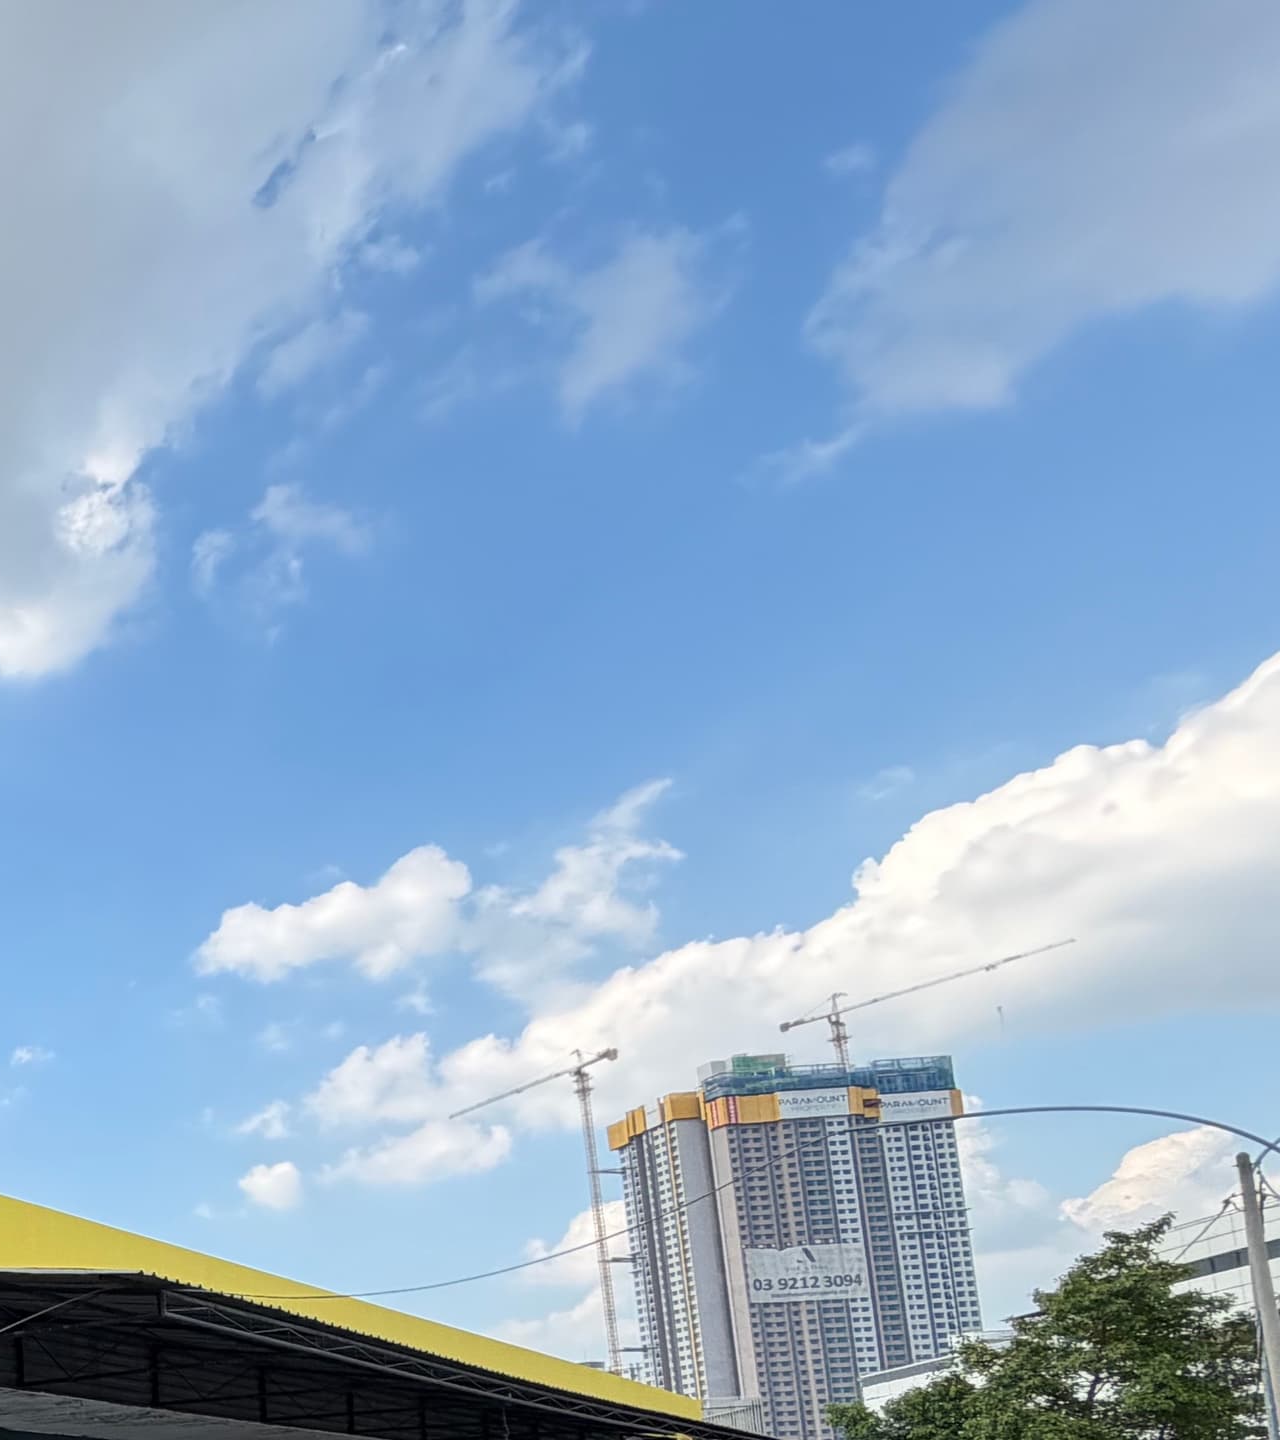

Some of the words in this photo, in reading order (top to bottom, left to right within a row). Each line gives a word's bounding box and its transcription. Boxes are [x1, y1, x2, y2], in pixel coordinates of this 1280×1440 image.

[753, 1278, 773, 1291] 03
[778, 1276, 821, 1290] 9212
[824, 1273, 863, 1287] 3094
